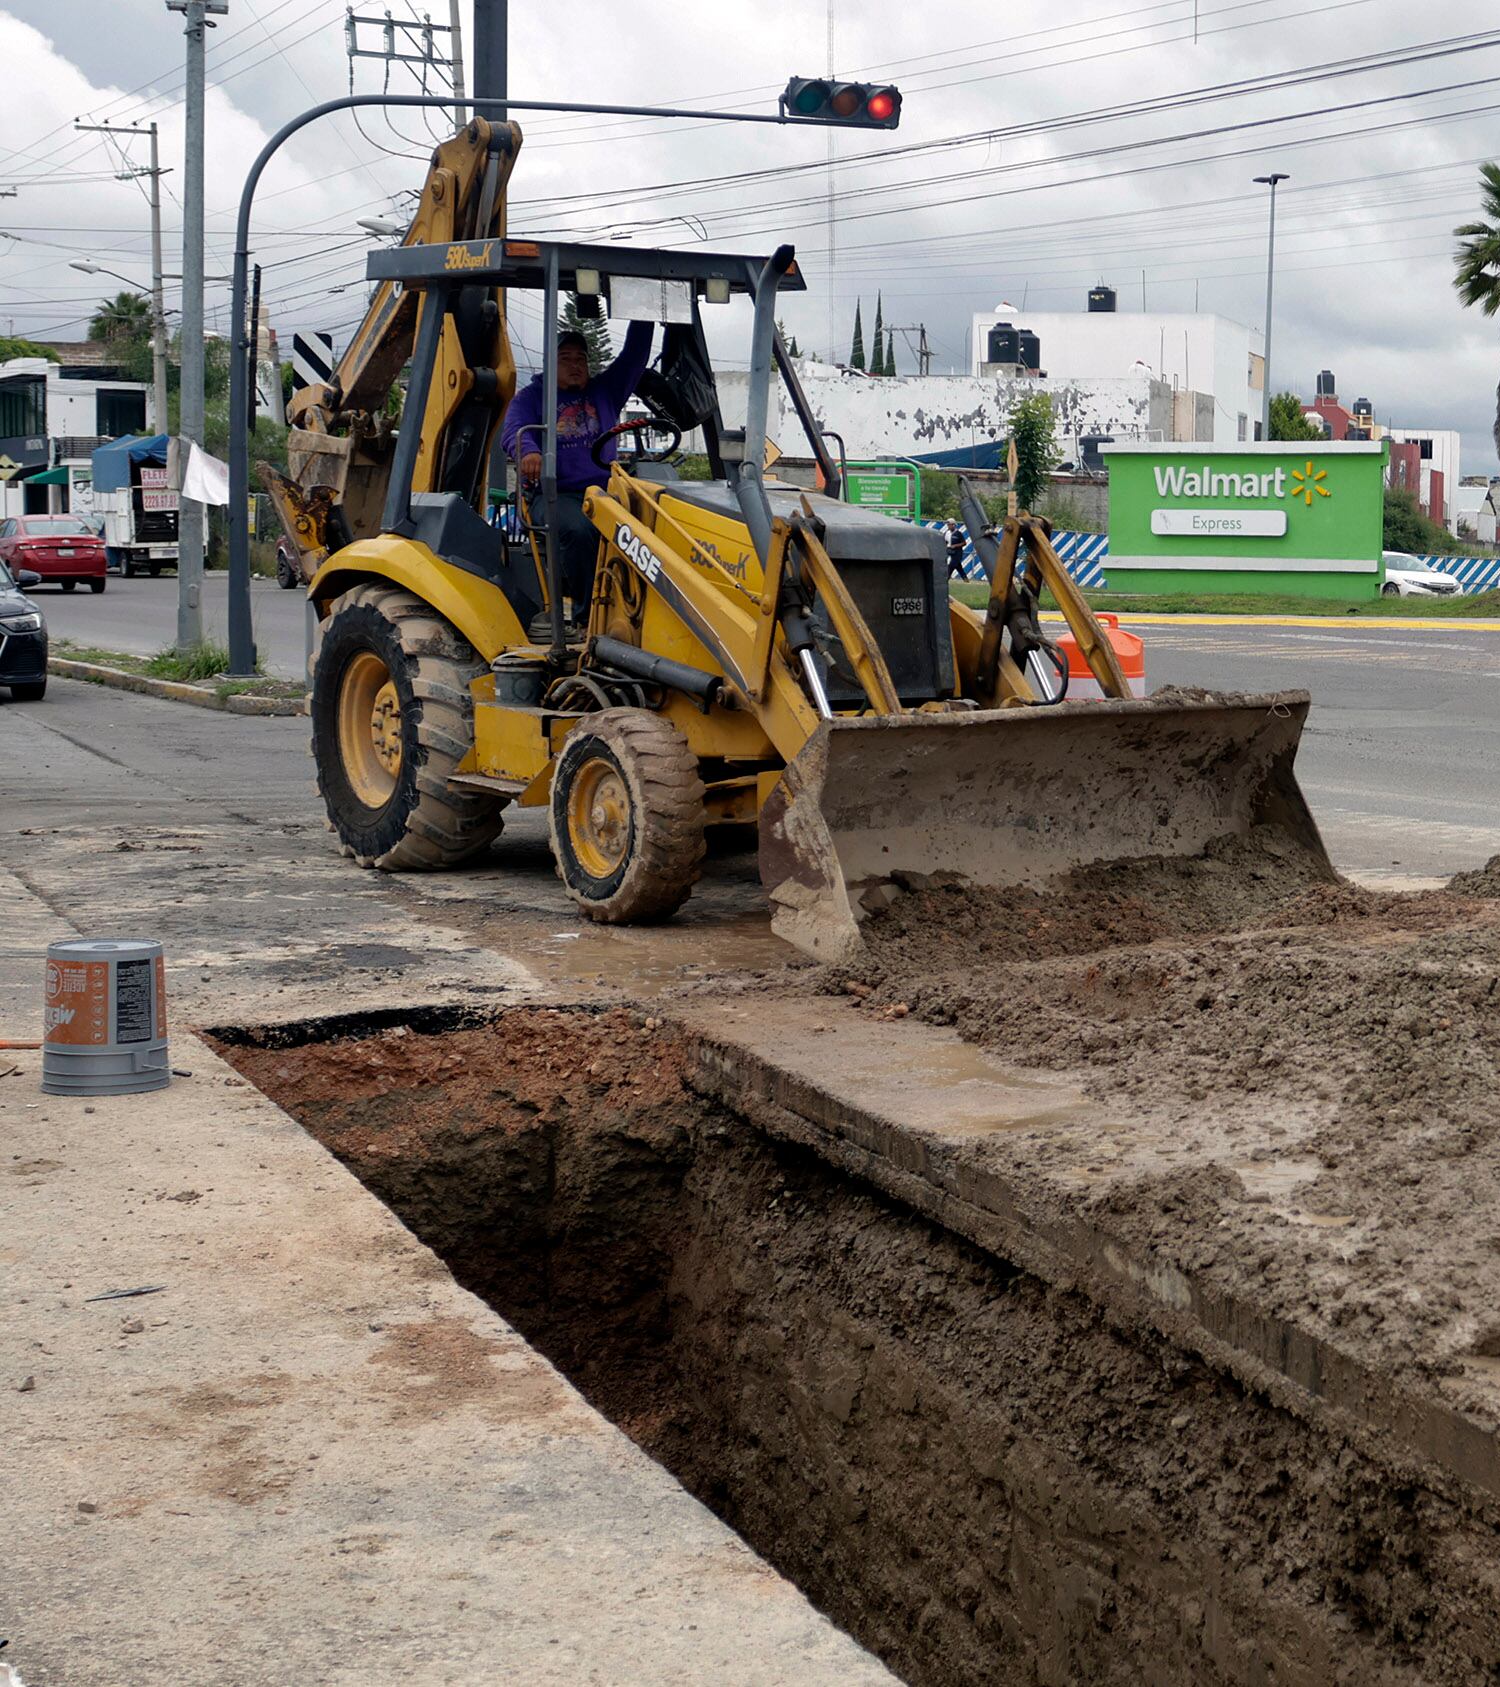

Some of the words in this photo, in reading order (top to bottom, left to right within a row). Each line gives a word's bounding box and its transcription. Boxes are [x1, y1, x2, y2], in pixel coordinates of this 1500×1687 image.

[1153, 466, 1286, 498] Walmart
[1192, 515, 1242, 532] Express
[617, 524, 662, 583] CASE
